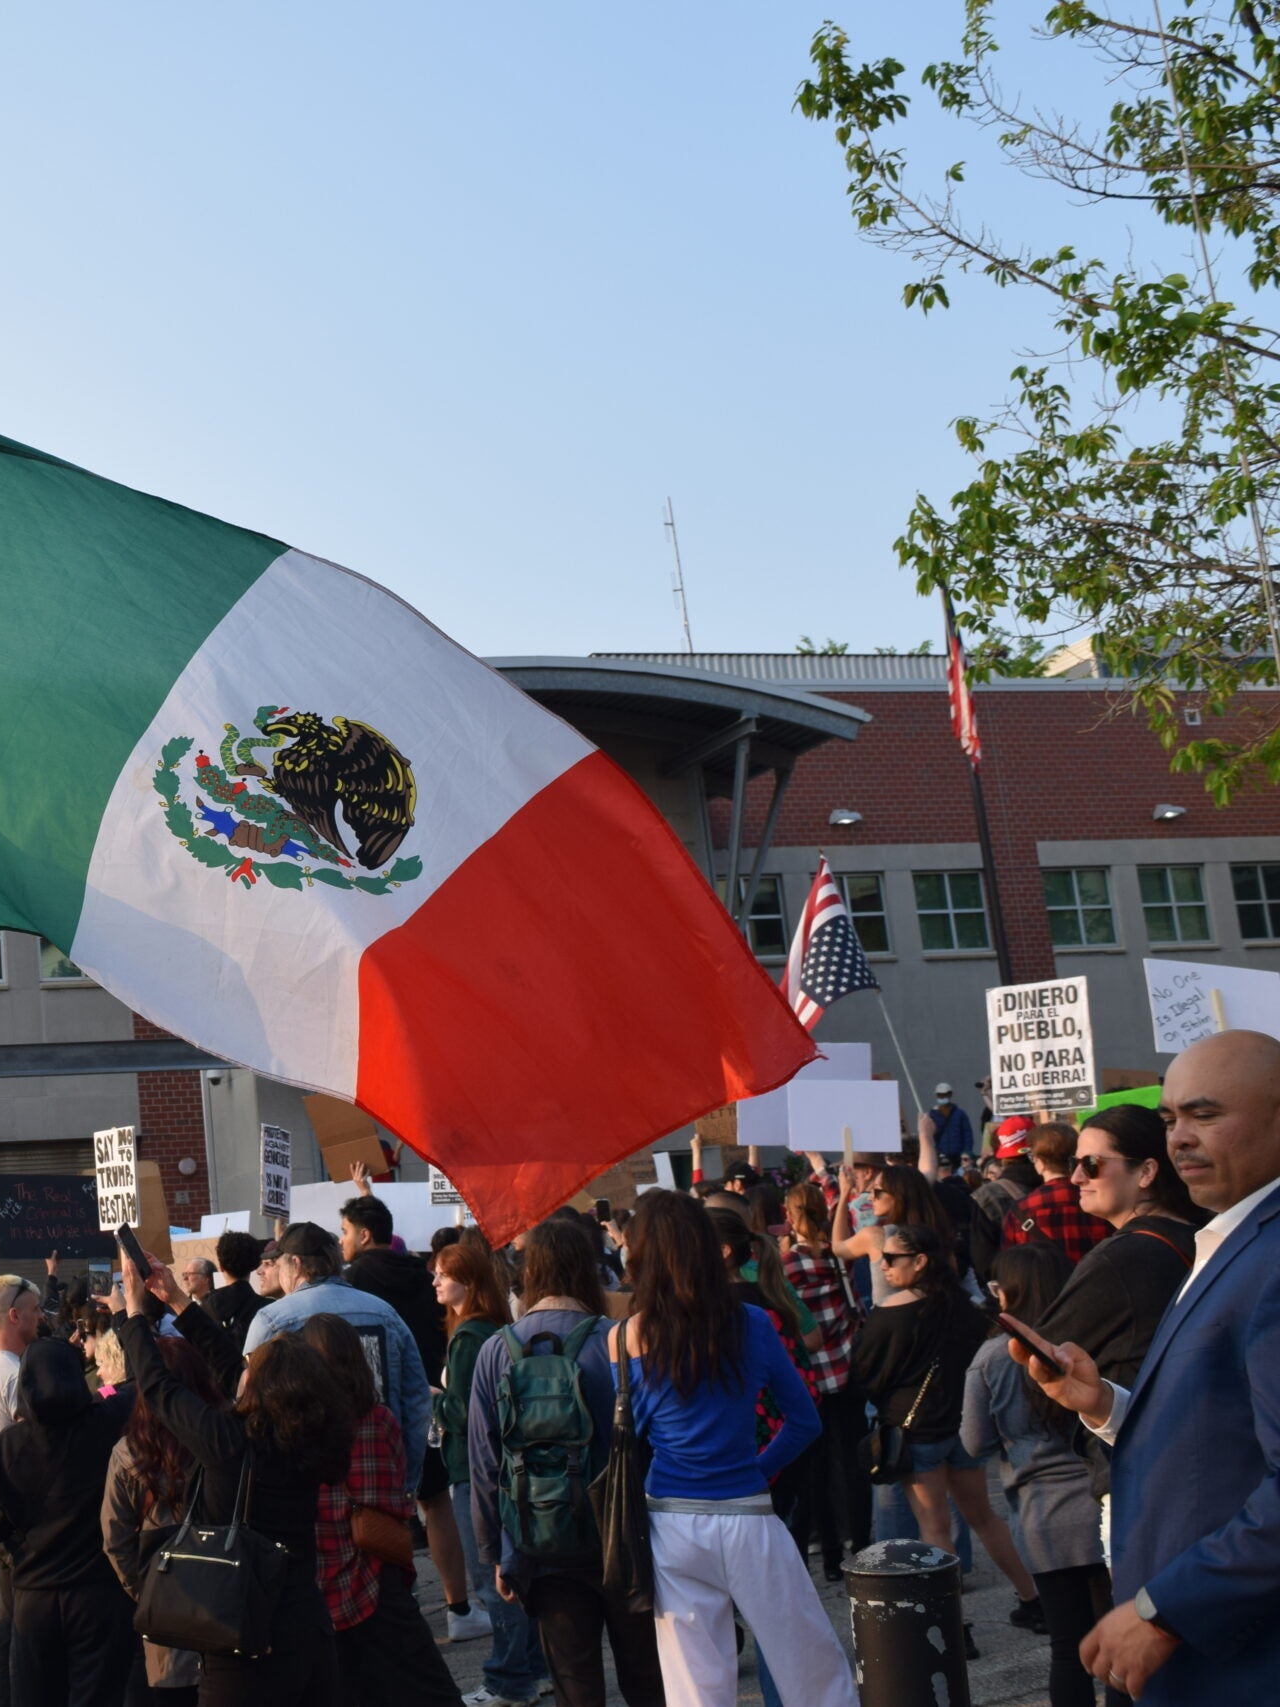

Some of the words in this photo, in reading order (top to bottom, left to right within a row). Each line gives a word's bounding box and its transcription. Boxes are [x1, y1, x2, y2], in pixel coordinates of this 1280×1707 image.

[1151, 987, 1173, 1002] No
[1173, 971, 1202, 989] One
[996, 984, 1078, 1018] ¡DINERO
[1016, 1011, 1044, 1021] PARA
[1048, 1007, 1059, 1018] EL
[996, 1016, 1083, 1045] PUEBLO,
[999, 1053, 1025, 1073] NO
[1031, 1047, 1085, 1069] PARA
[999, 1075, 1018, 1090] LA
[1022, 1067, 1086, 1088] GUERRA!
[96, 1134, 115, 1164] SAY
[117, 1129, 133, 1147] NO
[118, 1148, 132, 1162] TO
[433, 1181, 446, 1190] DE
[99, 1192, 137, 1224] GESTAPO
